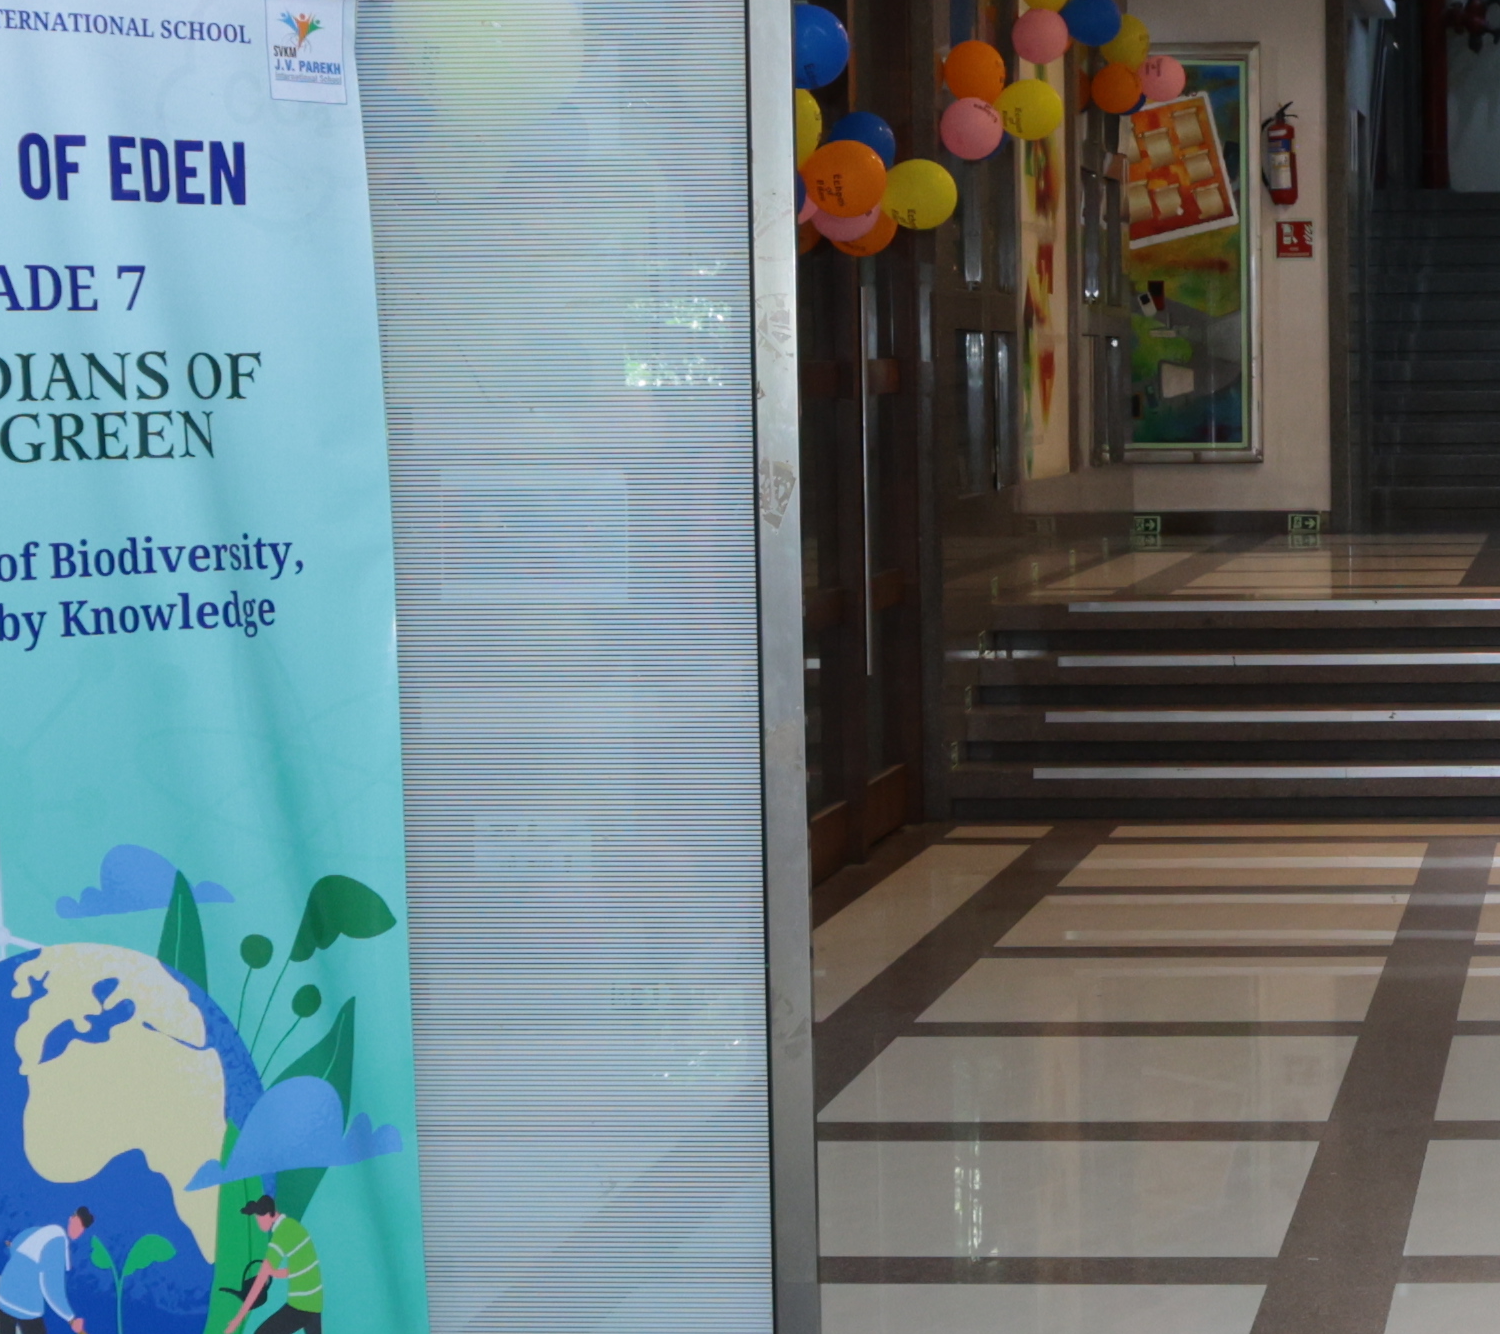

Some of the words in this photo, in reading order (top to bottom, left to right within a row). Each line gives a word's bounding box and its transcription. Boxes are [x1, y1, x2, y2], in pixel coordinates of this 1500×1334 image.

[161, 21, 251, 44] SCHOOL
[274, 45, 297, 58] SVKM
[299, 60, 341, 75] PAREKH
[18, 133, 86, 201] OF
[109, 136, 246, 206] EDEN
[116, 265, 146, 312] 7
[188, 352, 261, 400] OF
[0, 410, 214, 464] GREEN
[50, 533, 303, 578] Biodiversity,
[60, 592, 276, 638] Knowledge
